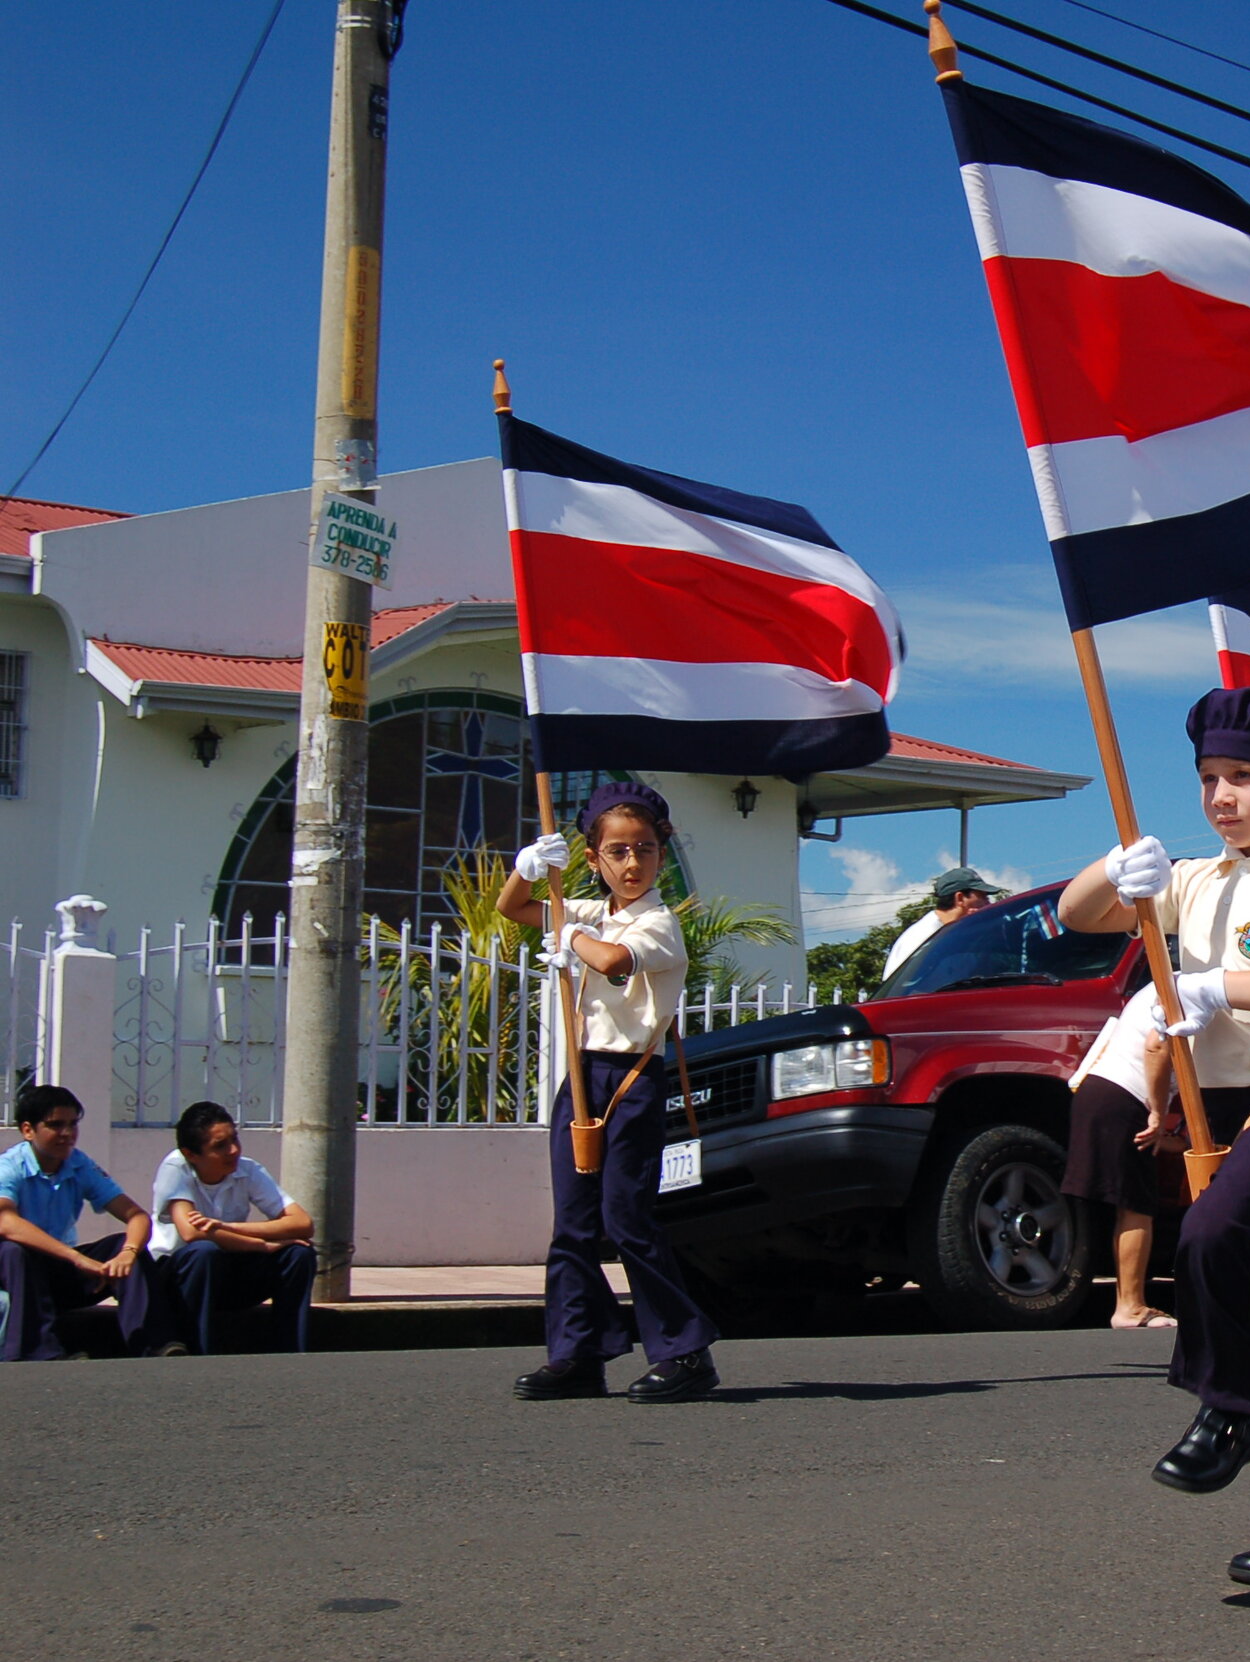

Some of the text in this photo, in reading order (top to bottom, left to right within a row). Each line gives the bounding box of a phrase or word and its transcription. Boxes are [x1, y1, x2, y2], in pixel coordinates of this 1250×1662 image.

[327, 501, 397, 539] APRENDA A
[661, 1154, 693, 1180] 1773
